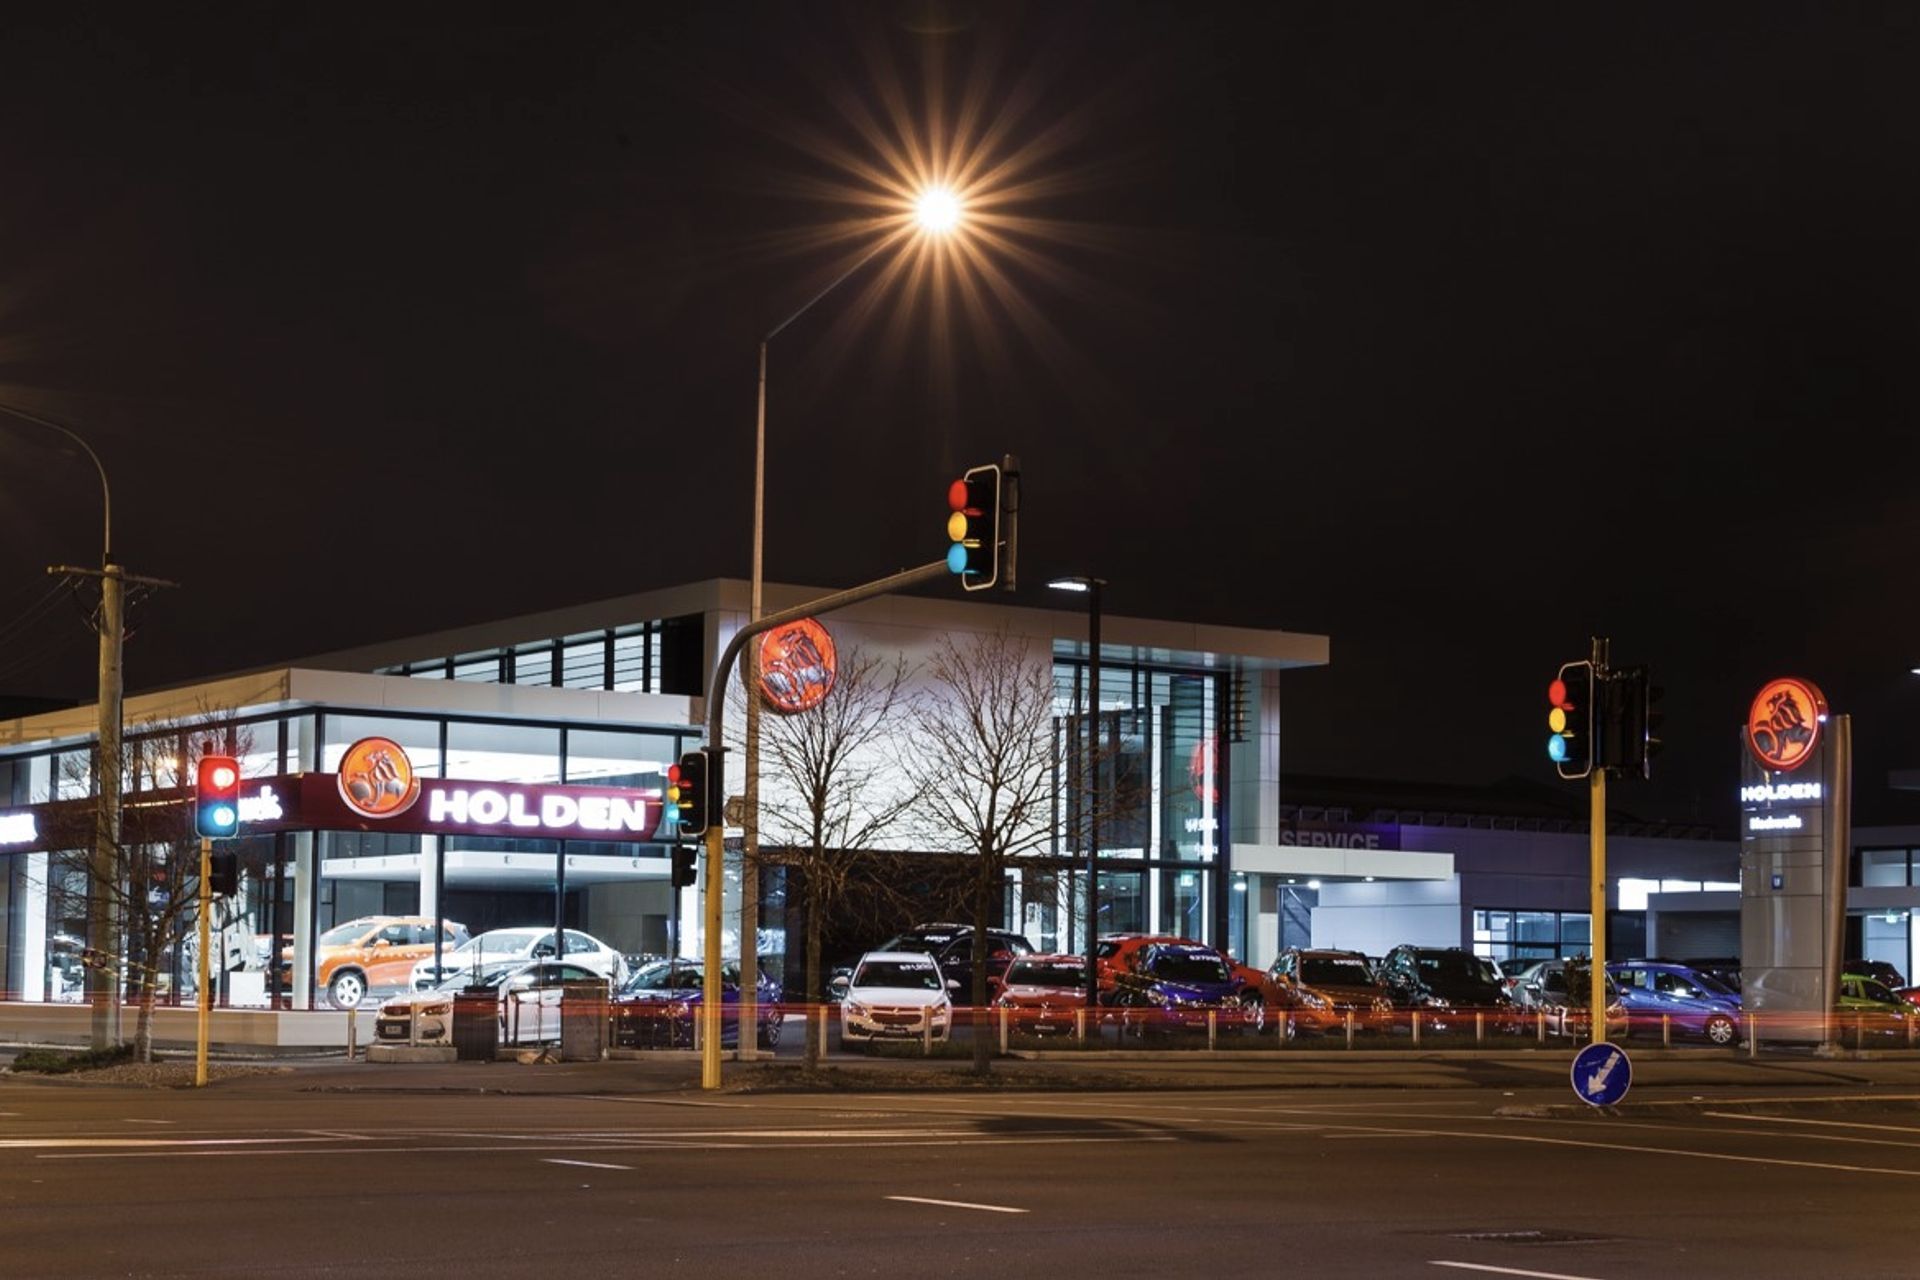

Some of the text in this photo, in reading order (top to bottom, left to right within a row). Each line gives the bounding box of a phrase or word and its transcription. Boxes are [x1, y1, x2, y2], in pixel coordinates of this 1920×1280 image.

[1741, 783, 1821, 801] HOLDEN
[429, 789, 645, 831] HOLDEN
[1281, 829, 1380, 849] SERVICE
